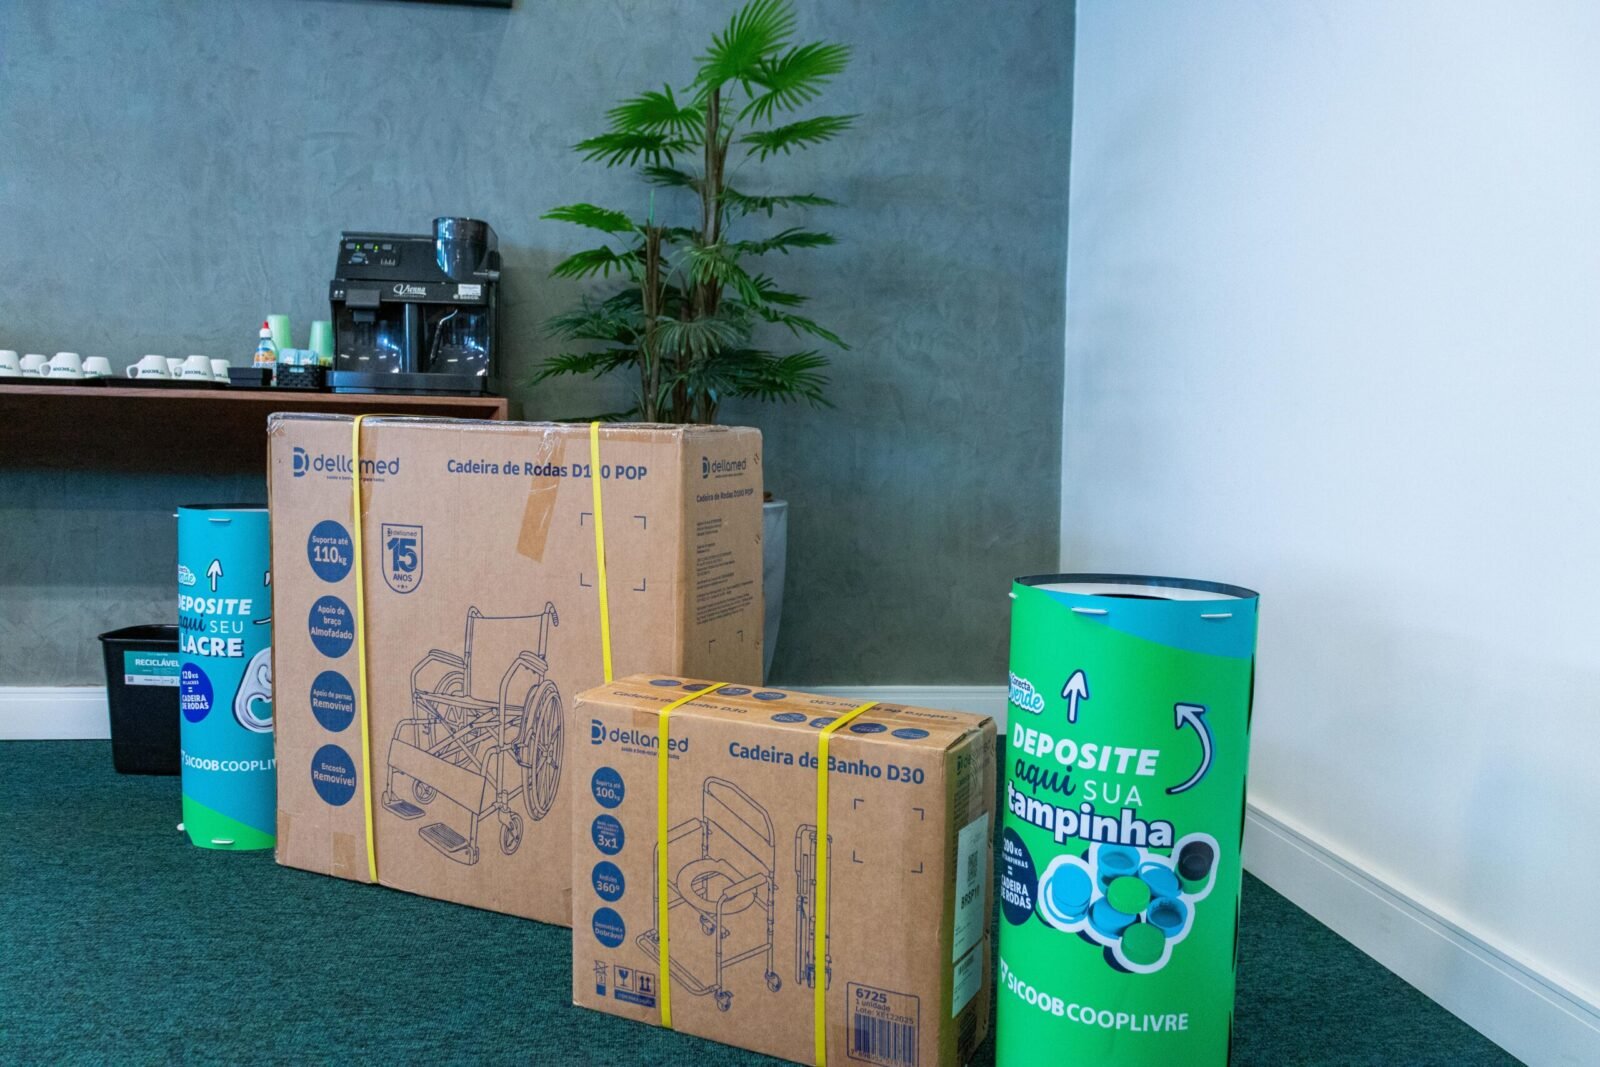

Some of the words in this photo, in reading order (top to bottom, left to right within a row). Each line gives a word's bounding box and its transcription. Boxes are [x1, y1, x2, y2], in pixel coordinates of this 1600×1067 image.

[313, 454, 400, 475] dellamed
[447, 459, 499, 474] Cadeira
[503, 461, 519, 475] de
[524, 462, 568, 477] Rodas
[572, 464, 611, 479] D10
[615, 466, 647, 480] POP
[712, 458, 746, 472] dellamed
[312, 535, 336, 545] Suporta
[337, 537, 348, 546] até
[387, 538, 418, 573] 15
[393, 574, 413, 582] ANOS
[318, 605, 336, 615] Apoio
[337, 606, 345, 616] de
[210, 620, 243, 634] SEU
[323, 616, 342, 627] braço
[311, 626, 353, 639] Almofadado
[181, 633, 243, 657] LACRE
[135, 657, 179, 667] RECICLÁVEL
[182, 694, 207, 702] CADEIRA
[313, 689, 328, 697] Apoio
[1010, 687, 1044, 710] verde
[187, 702, 209, 710] RODAS
[313, 698, 353, 713] Removível
[609, 728, 689, 752] dellamed
[1013, 723, 1160, 776] DEPOSITE
[185, 754, 220, 771] SICOOB
[220, 759, 277, 772] COOPLIV
[321, 763, 346, 774] Encosto
[729, 742, 794, 765] Cadeira
[798, 752, 818, 769] de
[827, 756, 882, 779] Banho
[887, 765, 925, 785] D30
[314, 770, 355, 787] Removível
[1015, 759, 1076, 796] aqui
[1083, 780, 1143, 807] SUA
[1007, 780, 1173, 847] tampinha
[597, 834, 618, 849] 3x1
[1001, 874, 1029, 897] CADEIRA
[1006, 889, 1032, 910] RODAS
[856, 987, 887, 1003] 6725
[1007, 972, 1065, 1017] SICOOB
[1066, 1003, 1189, 1032] COOPLIVRE
[861, 1001, 891, 1012] unidade
